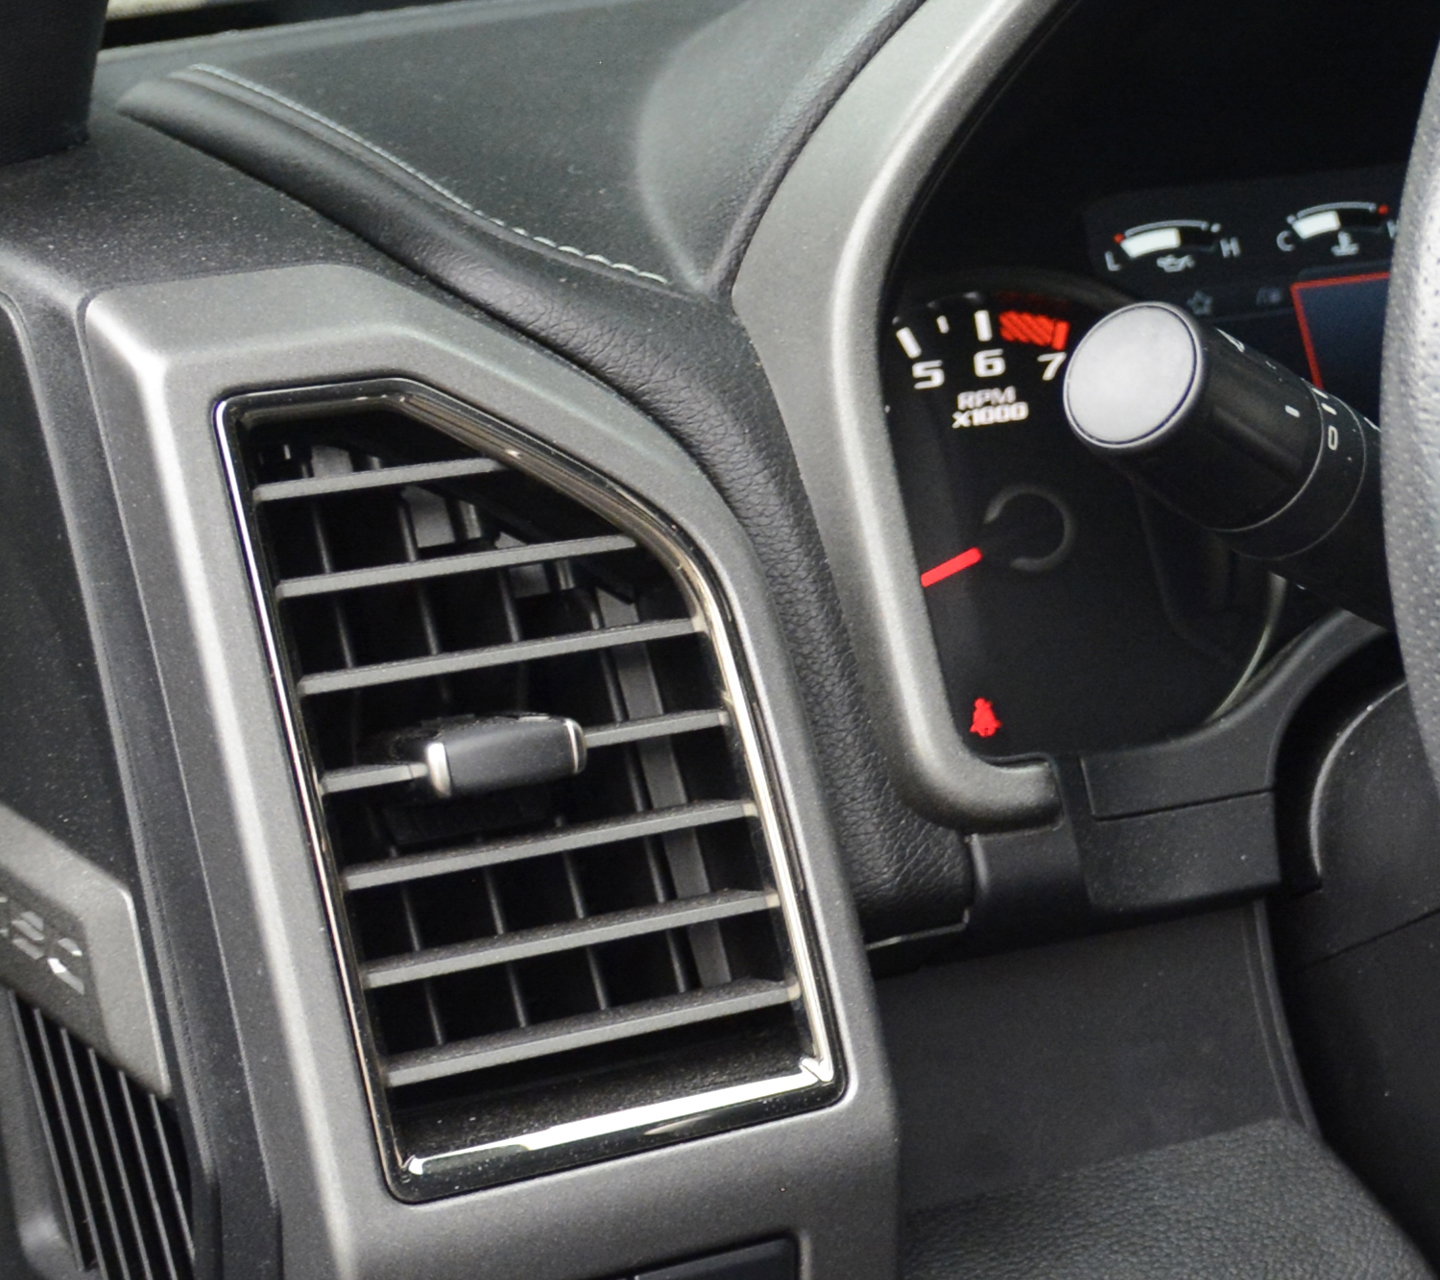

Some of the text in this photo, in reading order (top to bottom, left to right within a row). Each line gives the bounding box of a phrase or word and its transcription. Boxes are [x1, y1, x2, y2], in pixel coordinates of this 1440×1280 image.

[912, 348, 1067, 390] 5 6 7
[957, 385, 1016, 410] RPM
